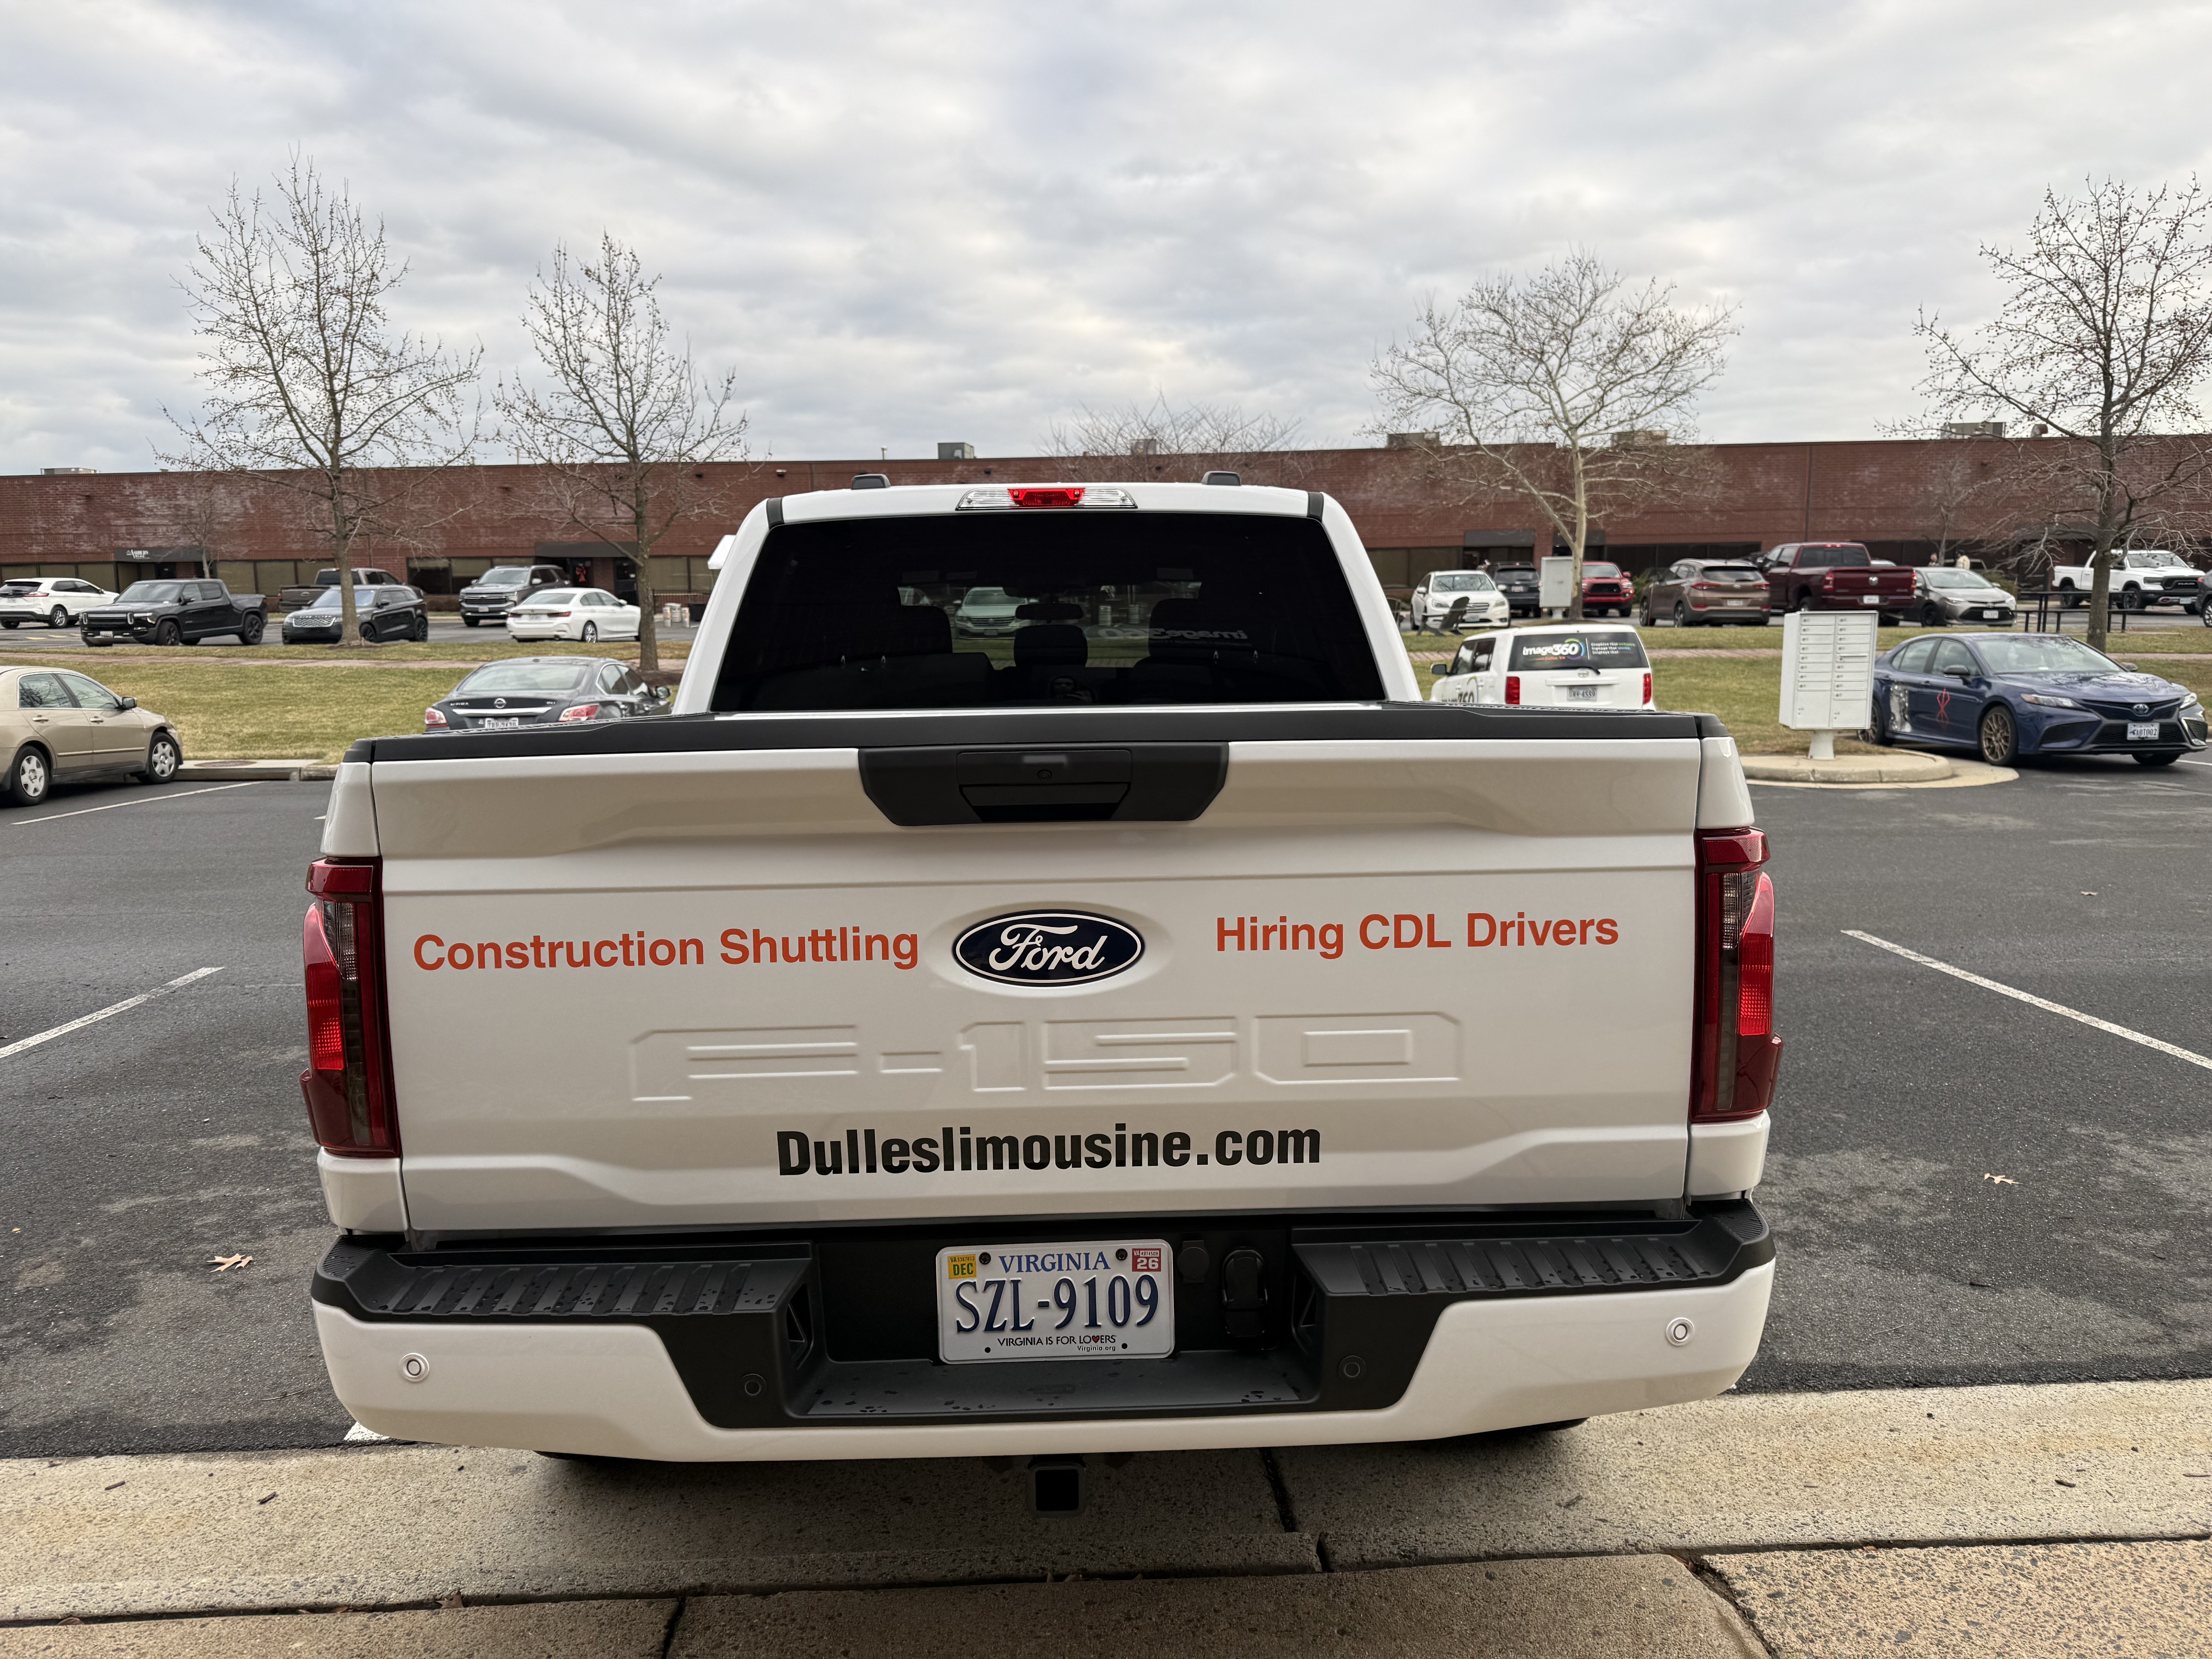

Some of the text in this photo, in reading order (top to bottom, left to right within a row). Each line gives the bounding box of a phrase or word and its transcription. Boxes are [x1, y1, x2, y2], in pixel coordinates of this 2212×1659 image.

[1522, 643, 1579, 656] image360
[414, 926, 918, 970] Construction Shuttling
[989, 924, 1108, 970] Ford
[1217, 912, 1619, 959] Hiring CDL Drivers
[629, 1011, 1463, 1103] F-150
[777, 1123, 1320, 1176] Dulleslimousine.com
[953, 1263, 974, 1276] DEC
[998, 1251, 1111, 1273] VIRGINIA
[1137, 1257, 1159, 1269] 26
[955, 1274, 1159, 1333] SZL-9109
[998, 1337, 1044, 1346] VIRGINIA
[1046, 1336, 1053, 1345] IS
[1056, 1336, 1077, 1345] FOR
